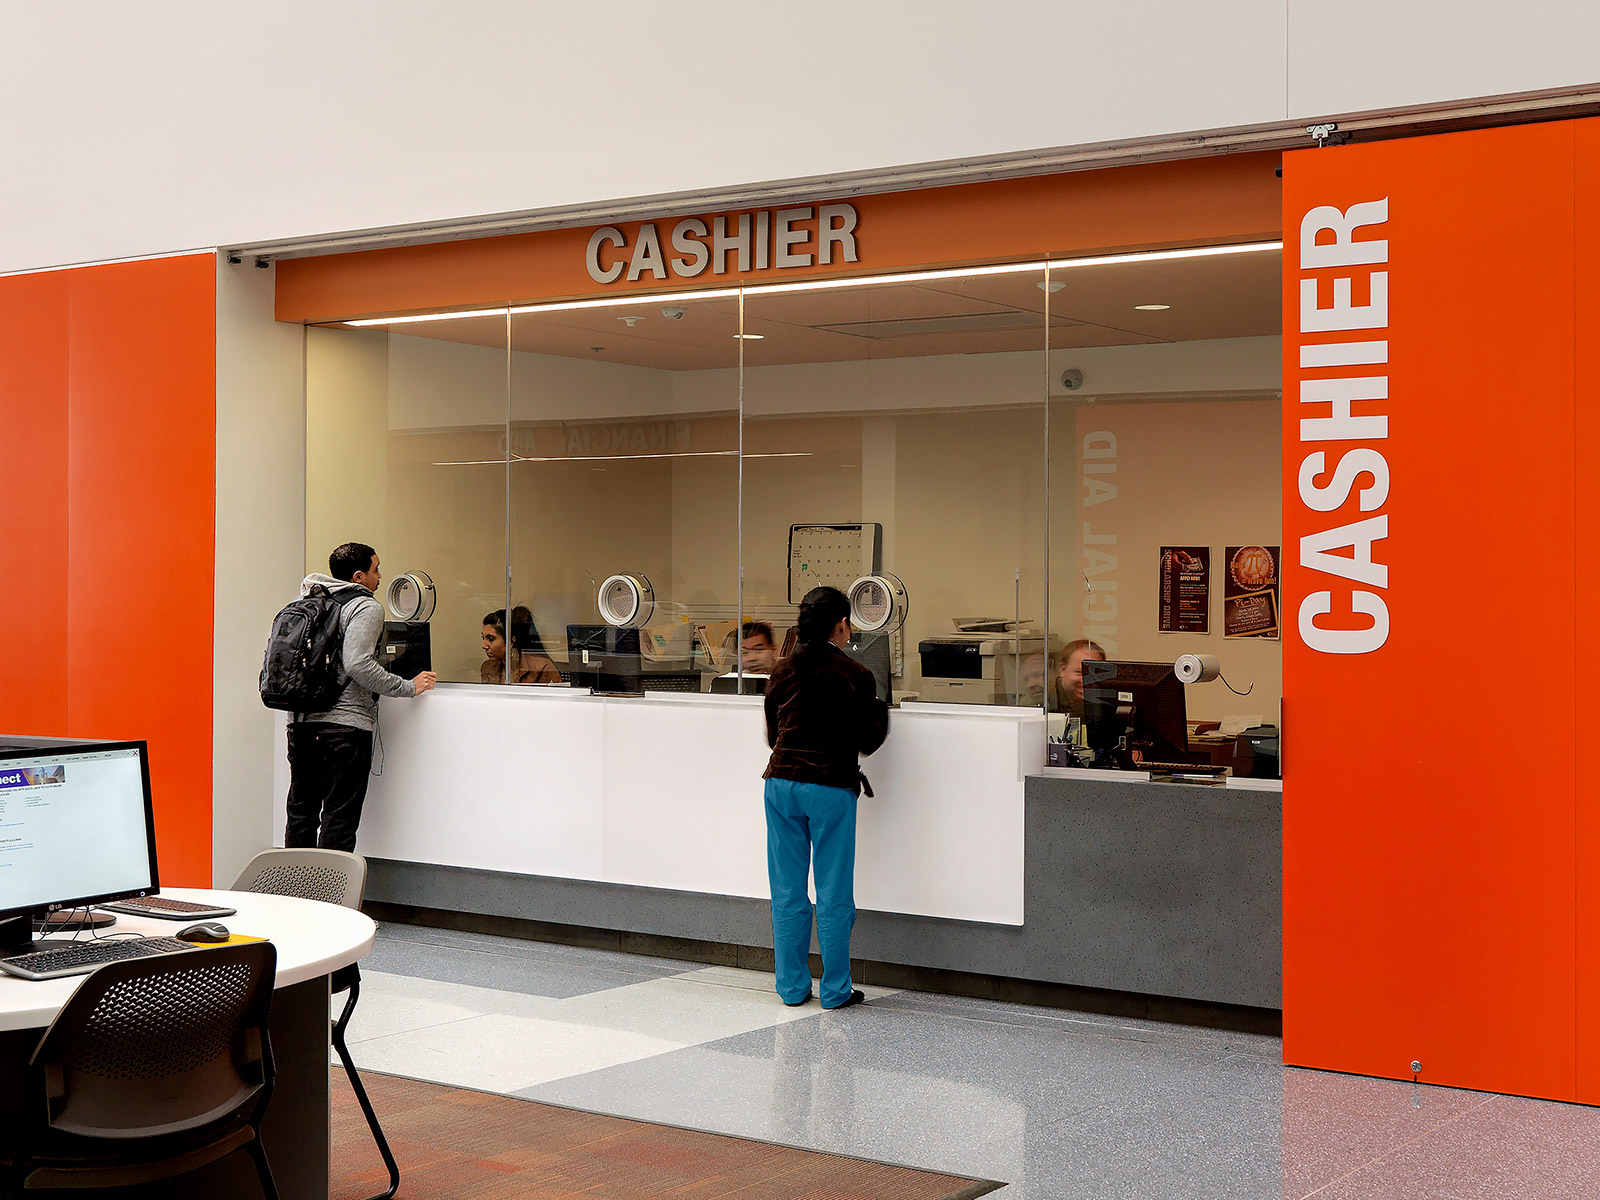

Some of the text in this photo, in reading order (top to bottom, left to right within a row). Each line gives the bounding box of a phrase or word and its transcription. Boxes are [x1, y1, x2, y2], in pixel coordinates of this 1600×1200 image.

[585, 203, 859, 284] CASHIER
[1298, 196, 1389, 654] CASHIER
[1163, 549, 1172, 629] SCHOLARSHIP DRIVE
[1234, 597, 1265, 607] Pi-Day
